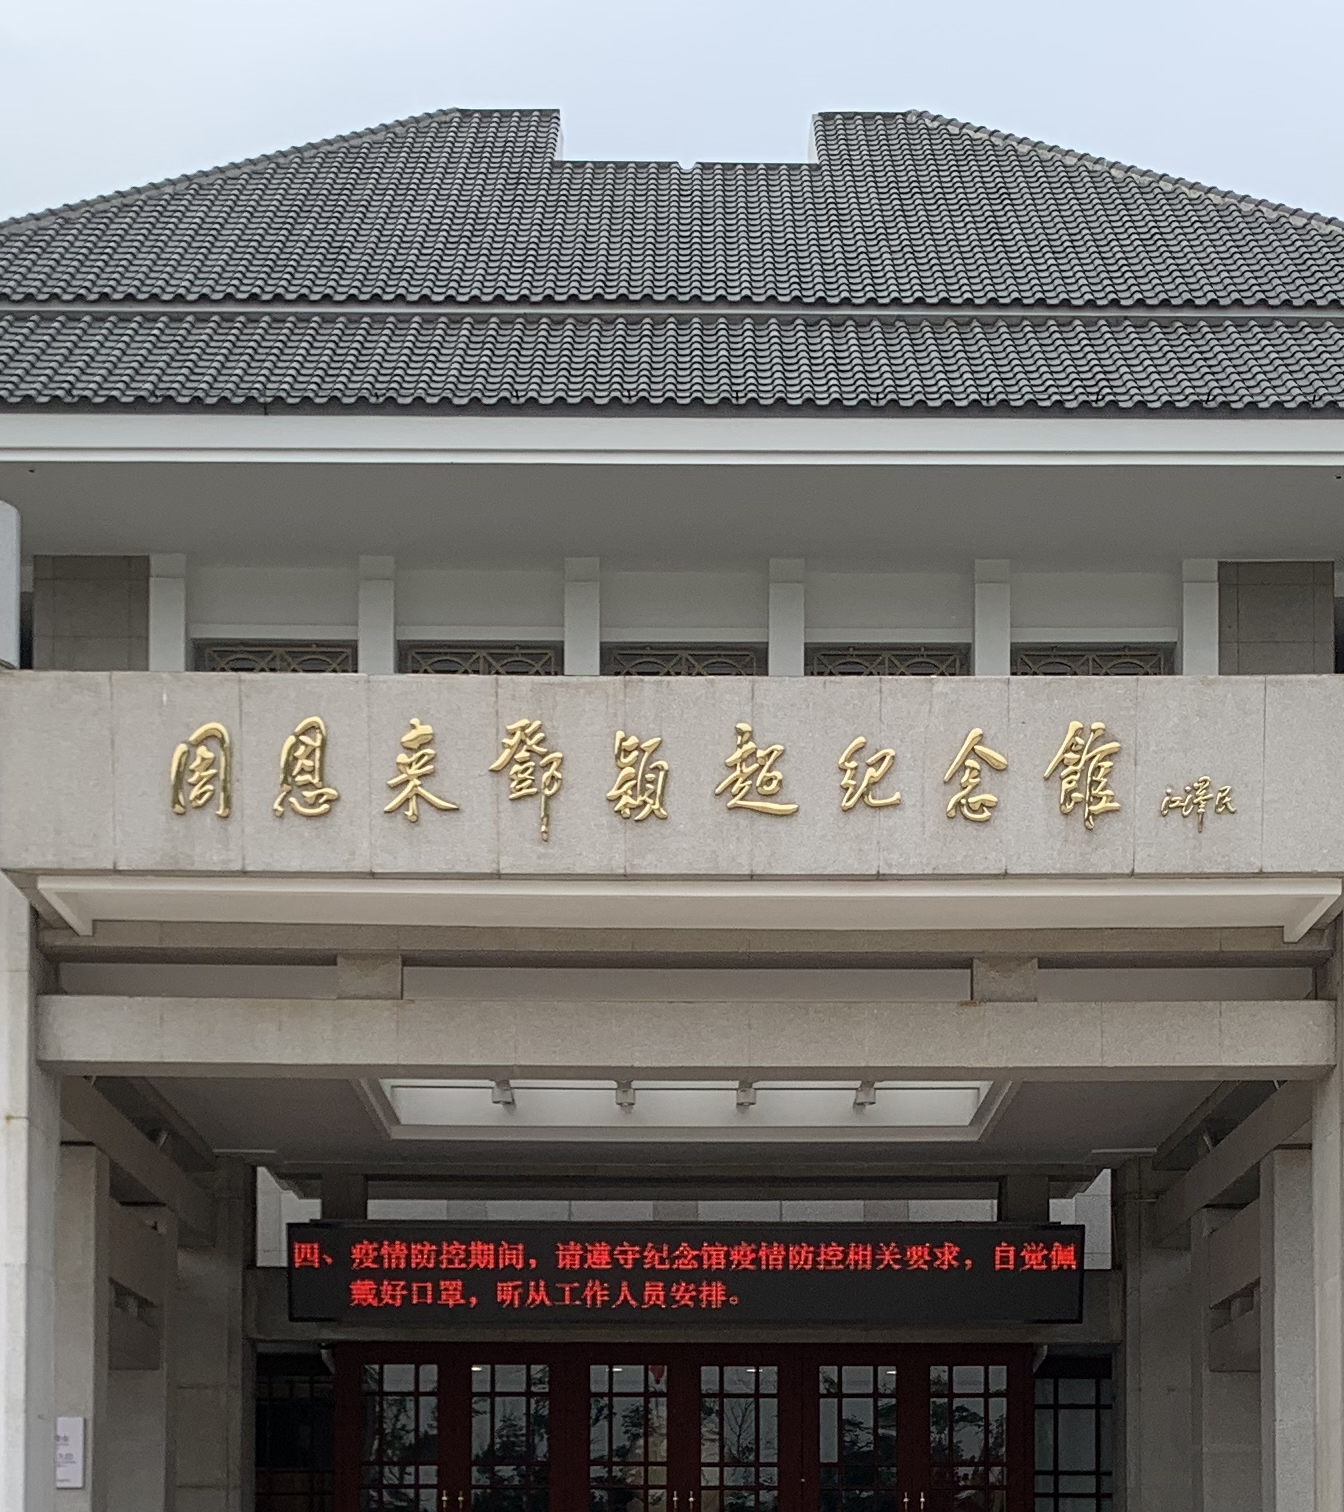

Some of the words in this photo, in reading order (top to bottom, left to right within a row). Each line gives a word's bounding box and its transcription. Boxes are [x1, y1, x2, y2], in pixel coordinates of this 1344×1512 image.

[349, 1279, 741, 1309] 戴好口罩，听从工作人员安排。
